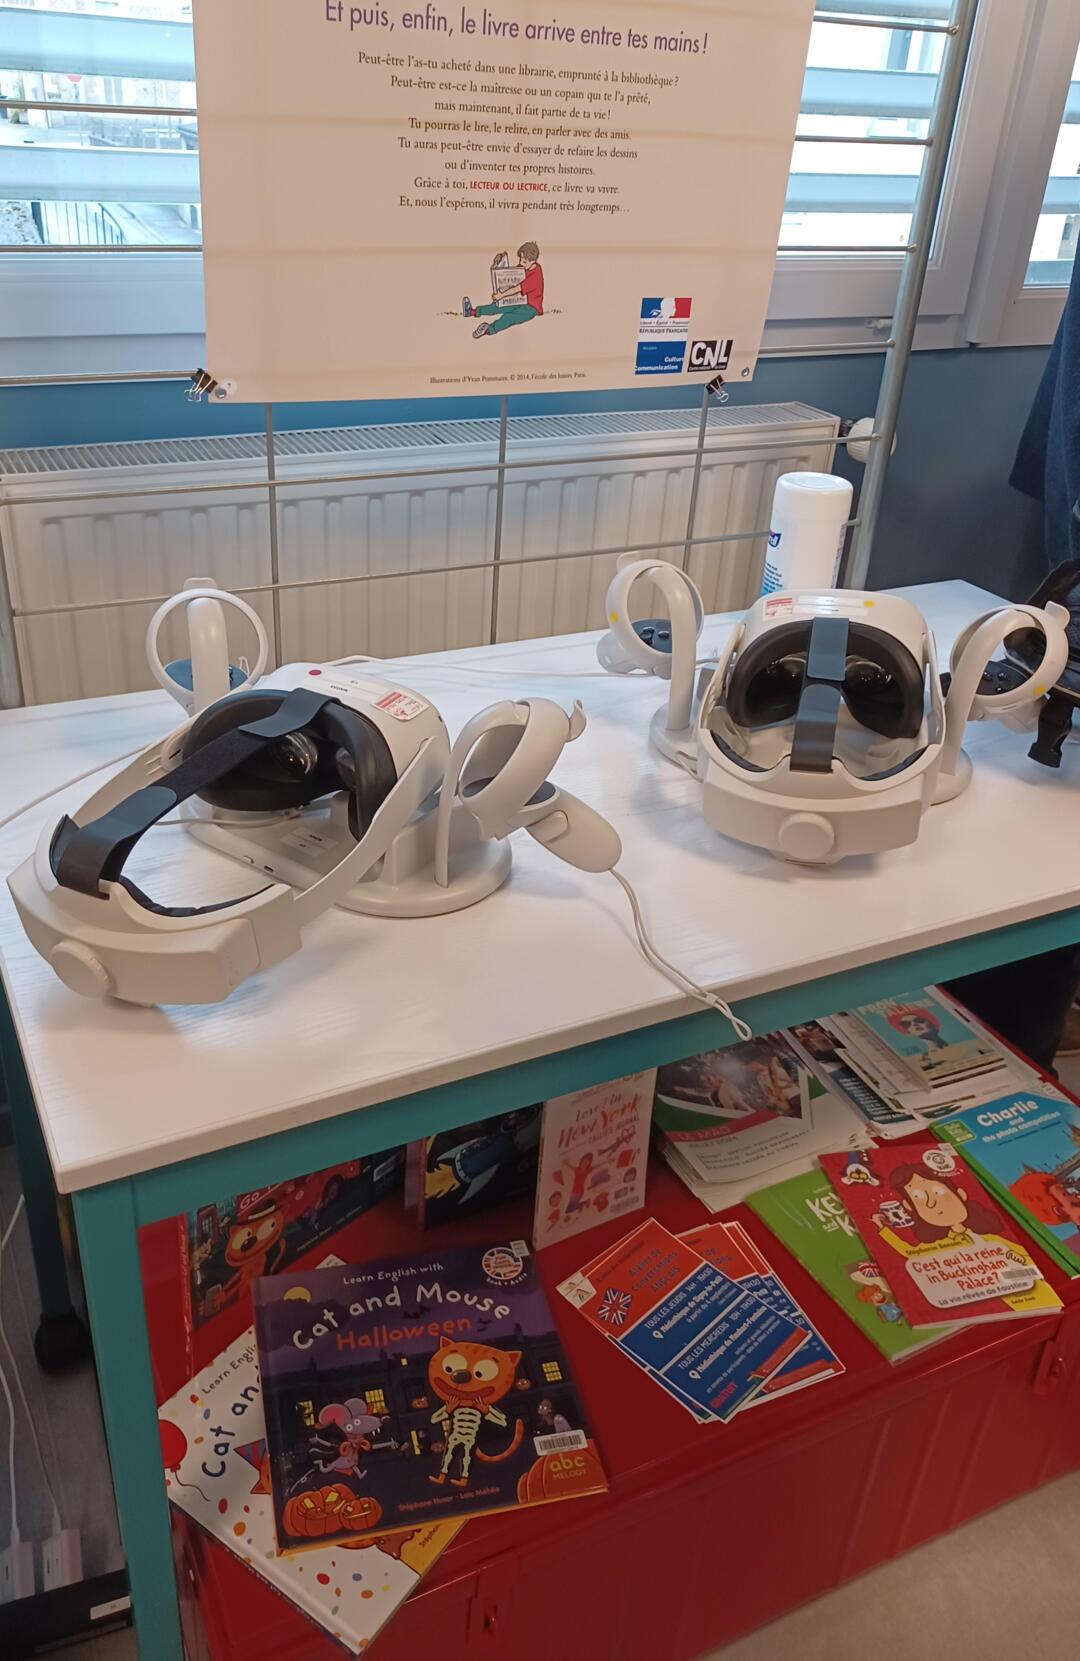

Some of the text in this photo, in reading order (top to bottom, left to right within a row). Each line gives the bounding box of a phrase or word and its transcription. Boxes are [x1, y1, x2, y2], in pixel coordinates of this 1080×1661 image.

[326, 0, 343, 22] Et
[350, 1, 394, 32] puis,
[402, 5, 452, 37] enfin,
[461, 8, 476, 34] le
[482, 9, 519, 38] livre
[525, 18, 574, 42] arrive
[580, 26, 621, 46] entre
[627, 28, 647, 49] tes
[358, 53, 404, 66] Peut-être
[408, 56, 437, 68] l'as-tu
[440, 59, 471, 71] acheté
[474, 61, 495, 73] dans
[498, 66, 515, 74] une
[518, 64, 556, 79] librairie,
[558, 70, 601, 82] emprunté
[604, 70, 608, 81] à
[611, 70, 618, 82] la
[391, 75, 435, 89] Peut-être
[439, 82, 466, 91] est-ce
[470, 80, 477, 92] la
[480, 82, 522, 95] maîtresse
[524, 88, 536, 96] ou
[554, 90, 583, 101] copain
[586, 92, 600, 103] qui
[604, 92, 612, 101] te
[614, 90, 624, 102] l'a
[626, 92, 650, 105] prêté,
[434, 100, 455, 111] mais
[458, 104, 513, 115] maintenant,
[516, 103, 521, 114] il
[524, 104, 538, 115] fait
[541, 107, 566, 119] partie
[569, 106, 580, 118] de
[583, 110, 590, 118] ta
[408, 118, 630, 139] Tu pourras le lire, le relire, en parler avec des amis.
[397, 136, 637, 158] Tu auras peut-être envie d'essayer de refaire les dessins
[460, 159, 506, 171] d'inventer
[509, 164, 520, 172] tes
[523, 165, 555, 176] propres
[558, 163, 594, 175] histoires.
[414, 176, 441, 188] Grâce
[444, 177, 449, 188] à
[452, 179, 468, 190] toi,
[470, 180, 499, 190] LECTEUR
[502, 182, 514, 190] OU
[517, 182, 550, 192] LECTRICE,
[552, 184, 561, 192] ce
[564, 181, 583, 192] livre
[598, 186, 619, 194] vivre.
[399, 195, 574, 212] Et, nous l'espérons, il vivra pendant très
[691, 340, 731, 368] CNL
[976, 1100, 1038, 1126] Charlie
[996, 1128, 1017, 1138] photo
[912, 1246, 1004, 1272] C'est qui la reine
[926, 1260, 1007, 1284] in Buckingham
[343, 1262, 444, 1285] Learn English with
[956, 1271, 1000, 1290] Palace?
[292, 1282, 510, 1350] Cat and Mouse
[644, 1313, 660, 1329] TOUS
[656, 1305, 669, 1318] LES
[666, 1290, 686, 1309] JEUDIS
[336, 1318, 472, 1350] Halloween
[202, 1344, 256, 1394] Learn Engli
[677, 1353, 695, 1370] TOUS
[691, 1344, 703, 1357] LES
[201, 1426, 236, 1478] Cat
[550, 1452, 584, 1471] abc
